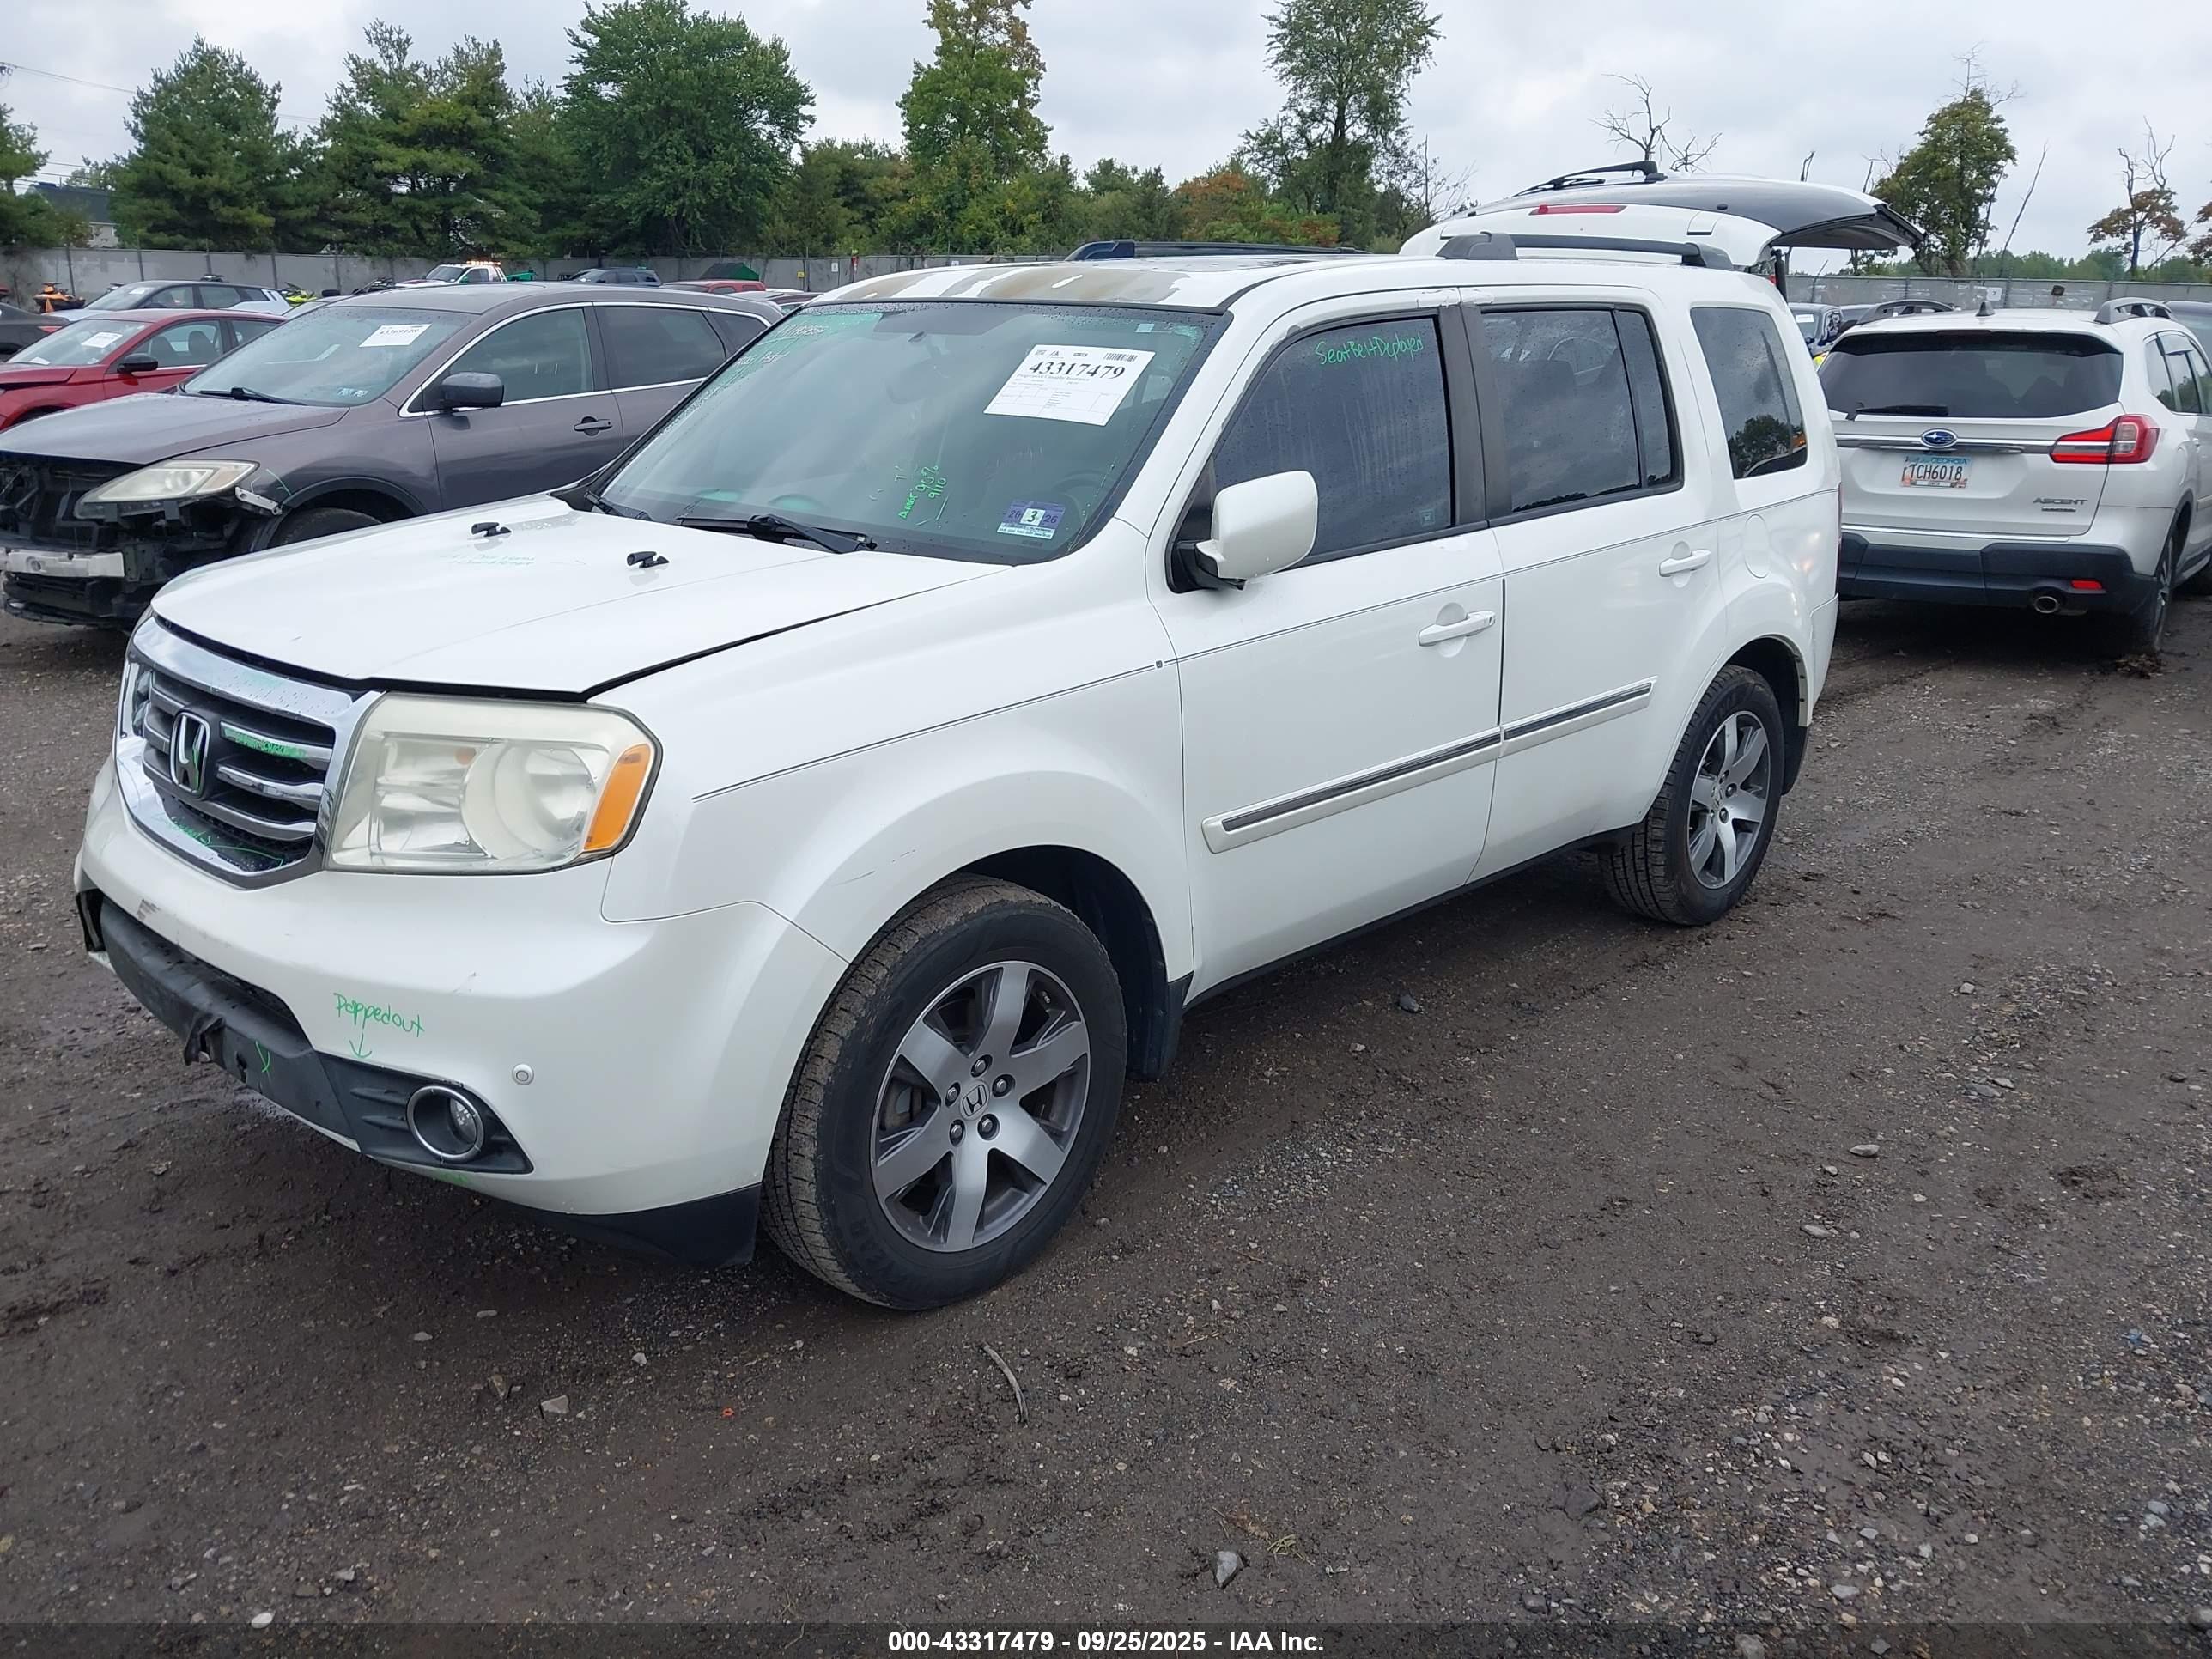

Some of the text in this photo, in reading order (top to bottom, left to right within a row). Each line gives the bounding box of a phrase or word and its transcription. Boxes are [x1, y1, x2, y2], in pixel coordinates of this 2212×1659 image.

[1029, 360, 1126, 380] 43317479
[1909, 464, 1963, 481] TCH6018
[2033, 497, 2088, 506] ASCENT
[1027, 510, 1038, 523] 3
[1043, 515, 1058, 524] 26
